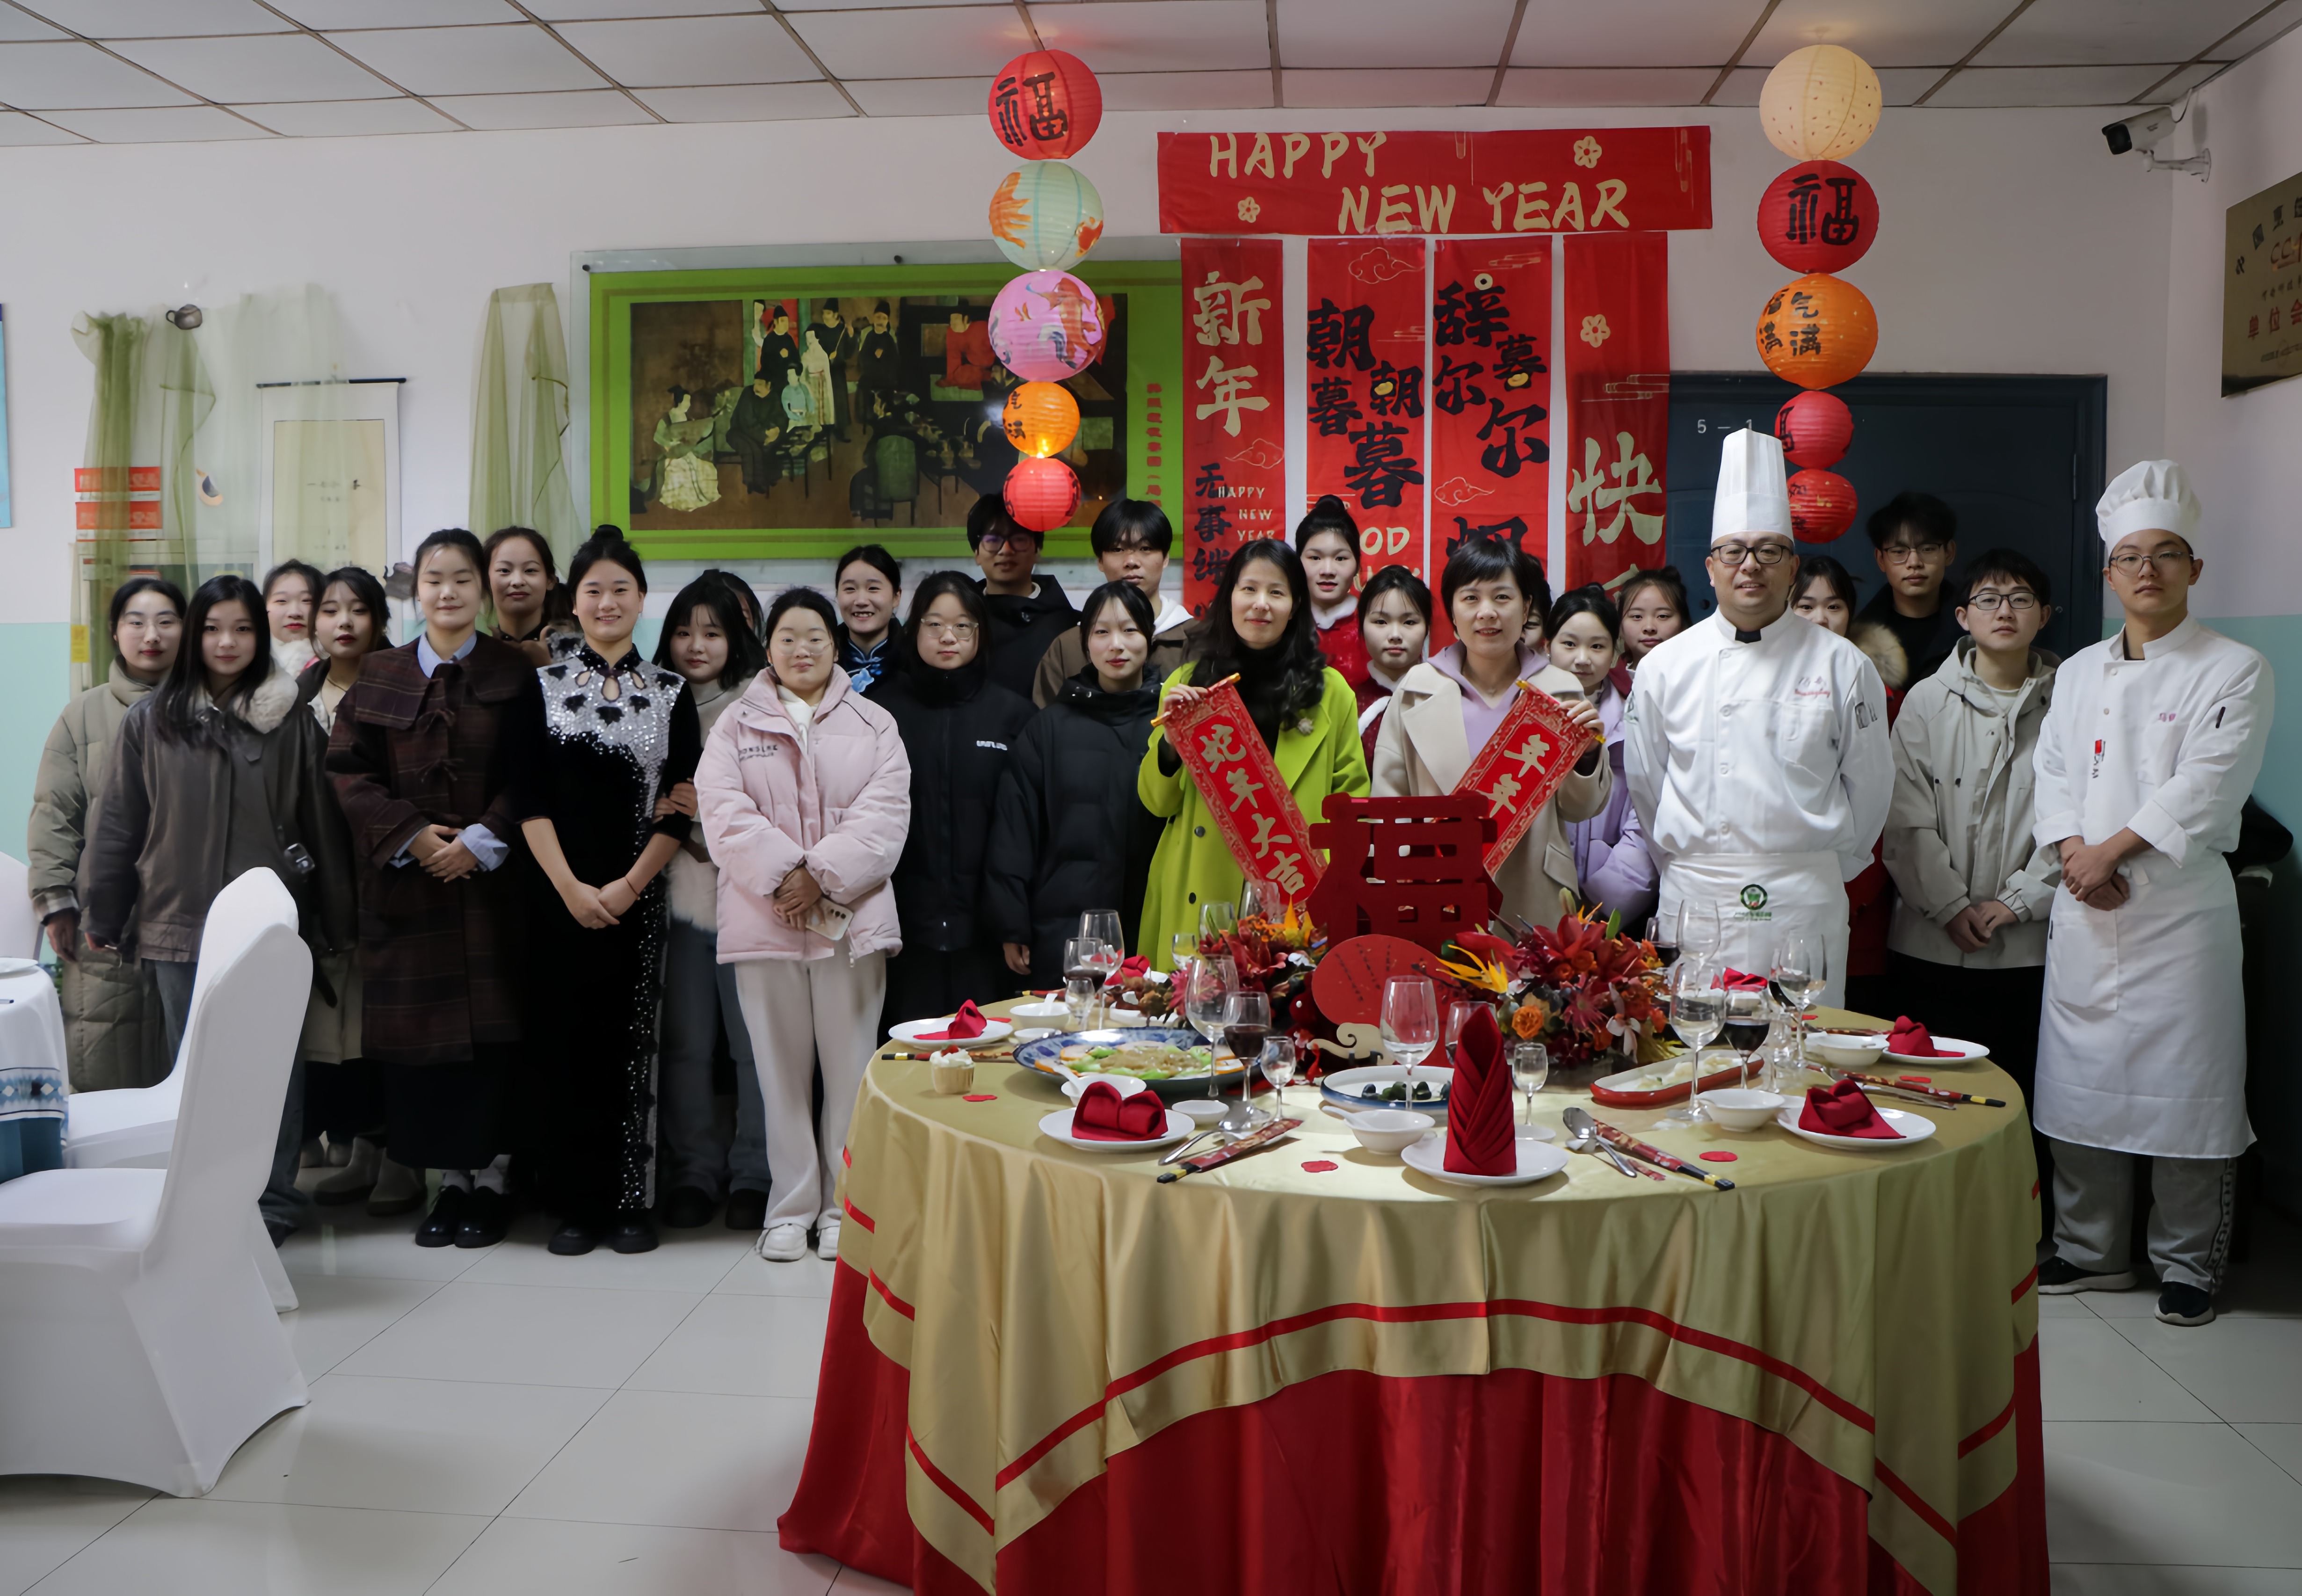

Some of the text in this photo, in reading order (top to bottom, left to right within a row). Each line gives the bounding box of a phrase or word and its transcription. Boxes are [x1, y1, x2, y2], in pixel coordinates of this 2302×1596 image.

[995, 71, 1068, 147] 福
[1210, 132, 1387, 178] HAPPY
[1338, 179, 1629, 235] NEW YEAR
[1786, 174, 1859, 246] 福
[1192, 270, 1271, 438] 新年
[1218, 486, 1265, 499] HAPPY
[1239, 508, 1273, 521] NEW
[1237, 530, 1275, 542] YEAR
[1359, 527, 1410, 556] OD
[1199, 724, 1305, 895] 蛇年大吉
